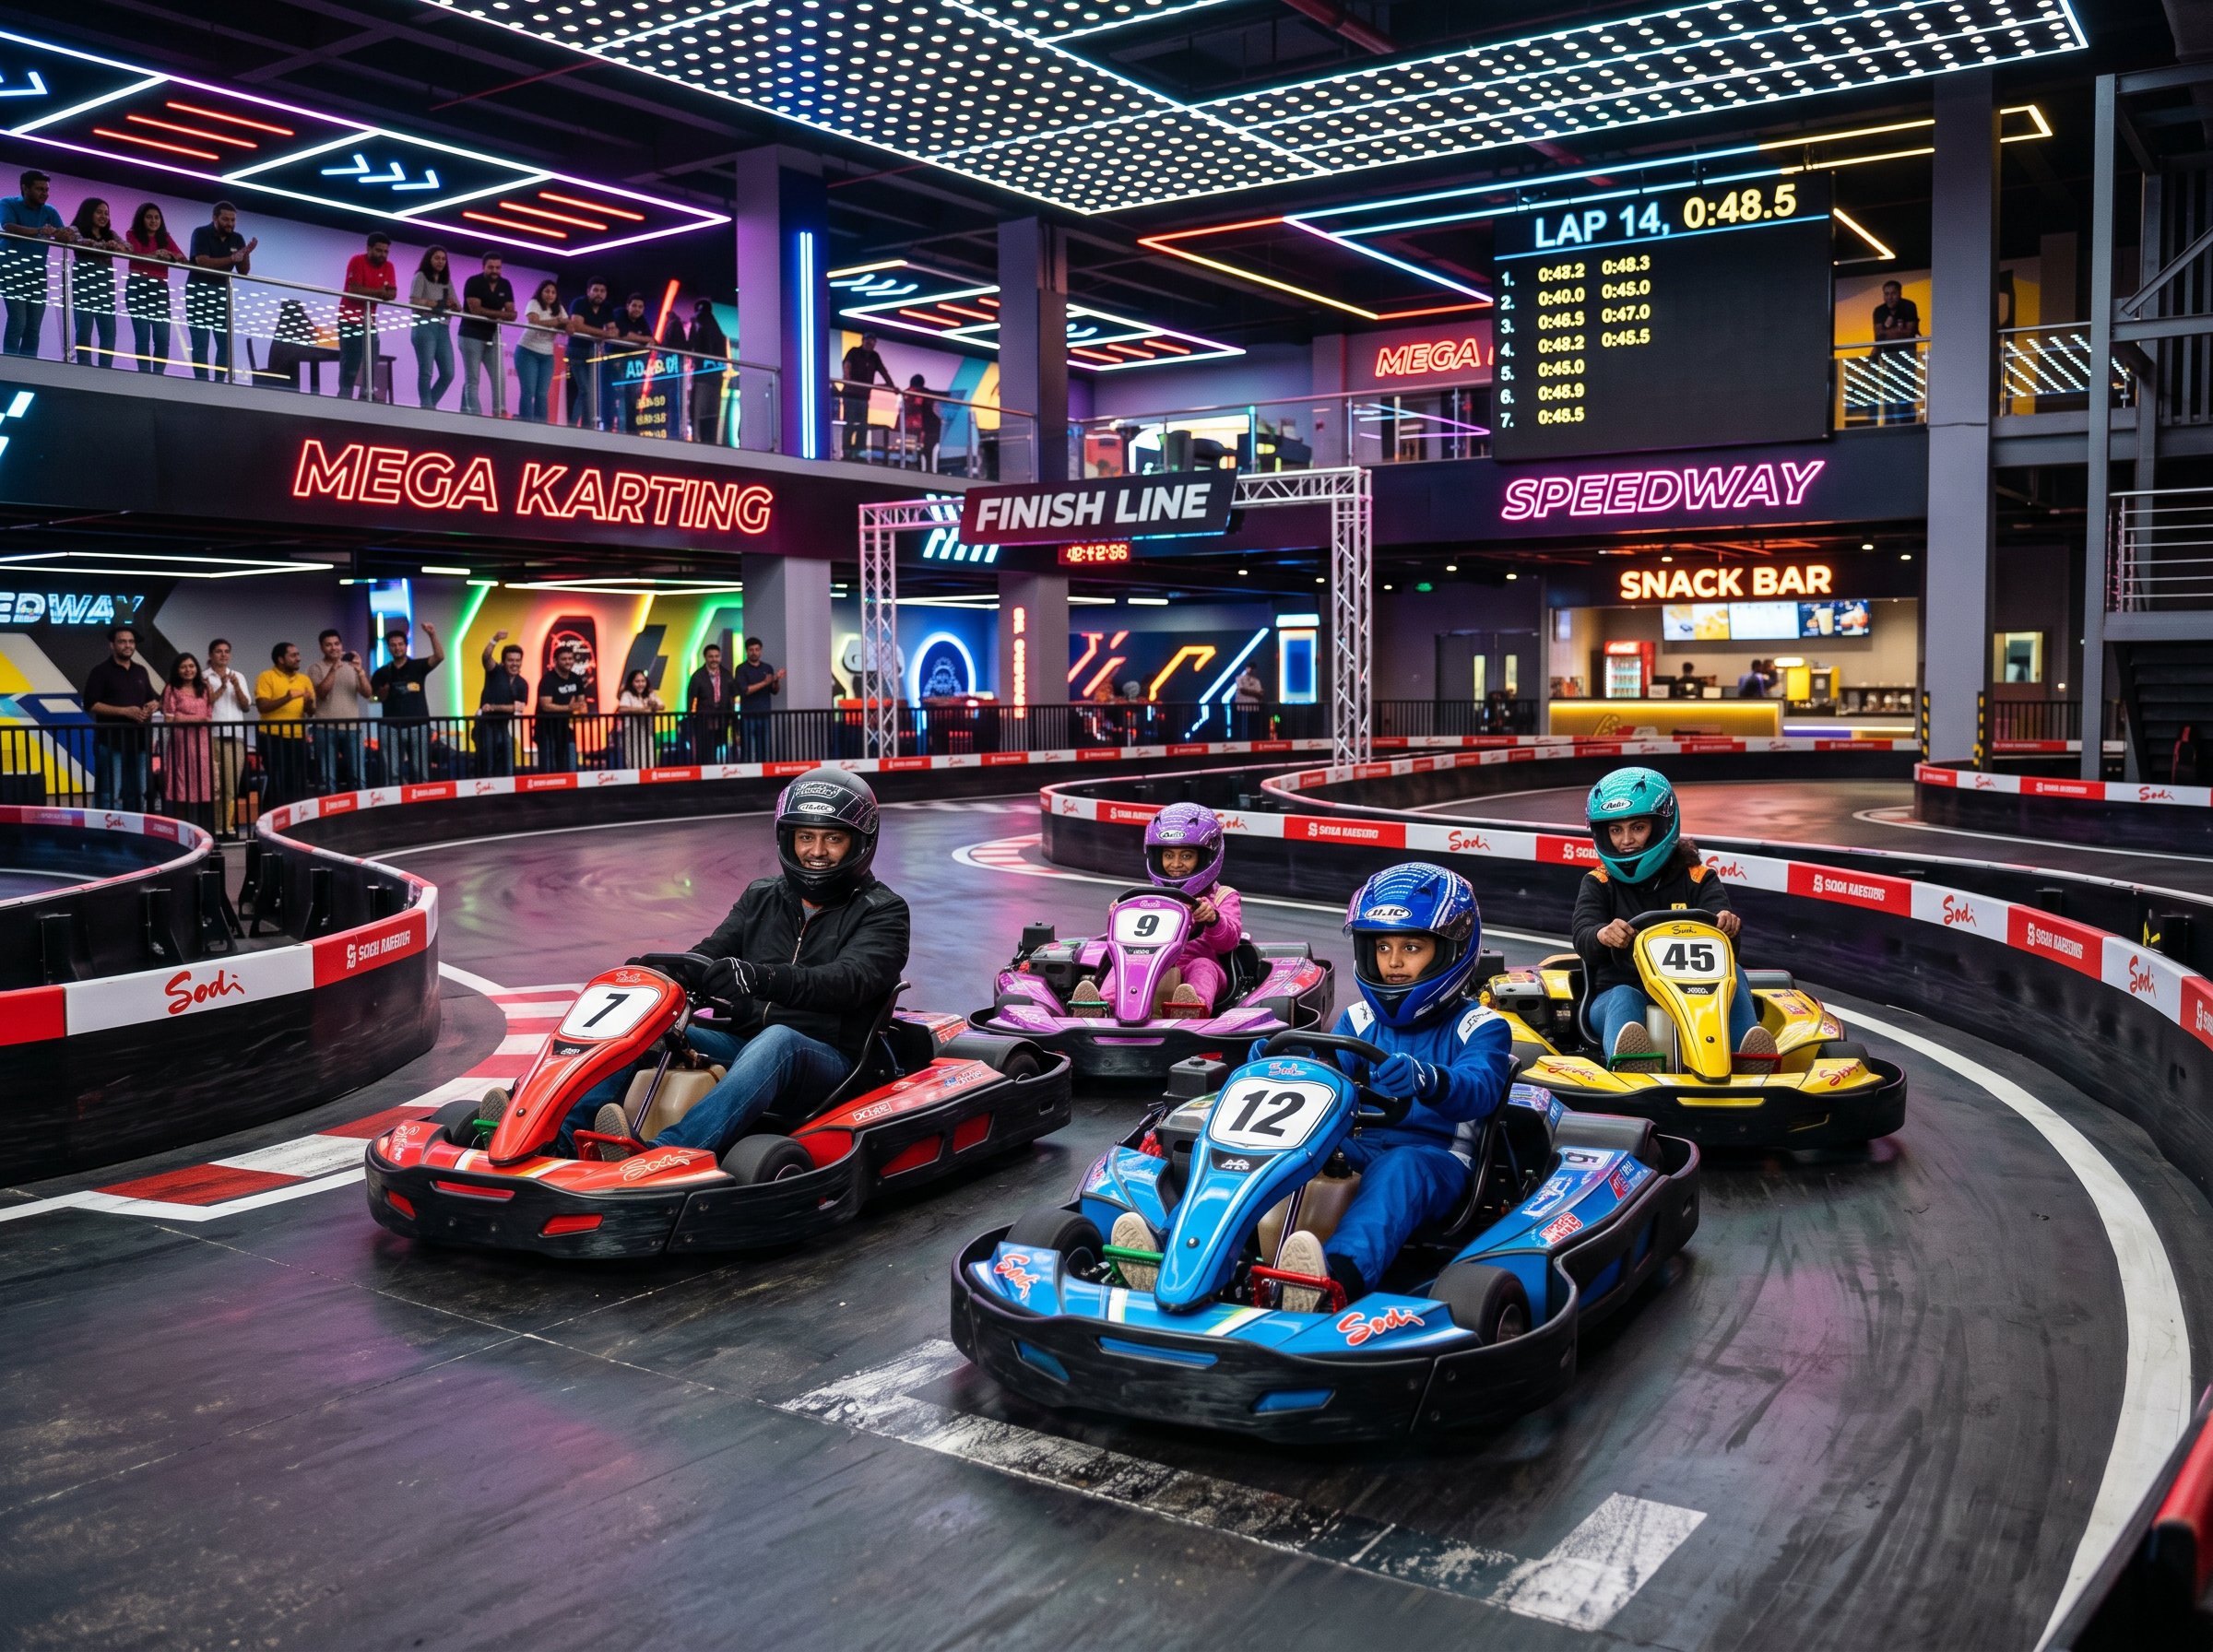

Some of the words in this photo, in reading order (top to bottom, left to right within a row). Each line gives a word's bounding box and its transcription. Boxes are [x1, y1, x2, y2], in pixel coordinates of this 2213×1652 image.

[1535, 209, 1607, 248] LAP
[1619, 201, 1671, 236] 14,
[1683, 183, 1797, 229] 0:48.5
[1501, 271, 1515, 287] 1.
[1601, 255, 1651, 275] 0:48.3
[1500, 294, 1515, 311] 2.
[1500, 318, 1515, 335] 3.
[1601, 303, 1651, 324] 0:47.0
[1375, 337, 1482, 378] MEGA
[1500, 341, 1515, 358] 4.
[1500, 365, 1515, 382] 5.
[1500, 388, 1515, 405] 6.
[1500, 412, 1515, 429] 7.
[293, 440, 499, 513] MEGA
[516, 463, 774, 535] KARTING
[1501, 460, 1826, 522] SPEEDWAY
[976, 490, 1106, 532] FINISH
[1114, 483, 1212, 524] LINE
[1620, 567, 1744, 600] SNACK
[1753, 564, 1832, 596] BAR
[1448, 831, 1492, 852] Sodi
[1706, 856, 1747, 880] Sodi
[1133, 914, 1160, 937] 9
[1943, 894, 1977, 926] Sodi
[1662, 943, 1716, 973] 45
[165, 970, 245, 1015] Sodi
[2128, 954, 2157, 999] Sodi
[582, 993, 631, 1028] 7
[1228, 1090, 1306, 1138] 12
[1337, 1308, 1426, 1346] Sodi
